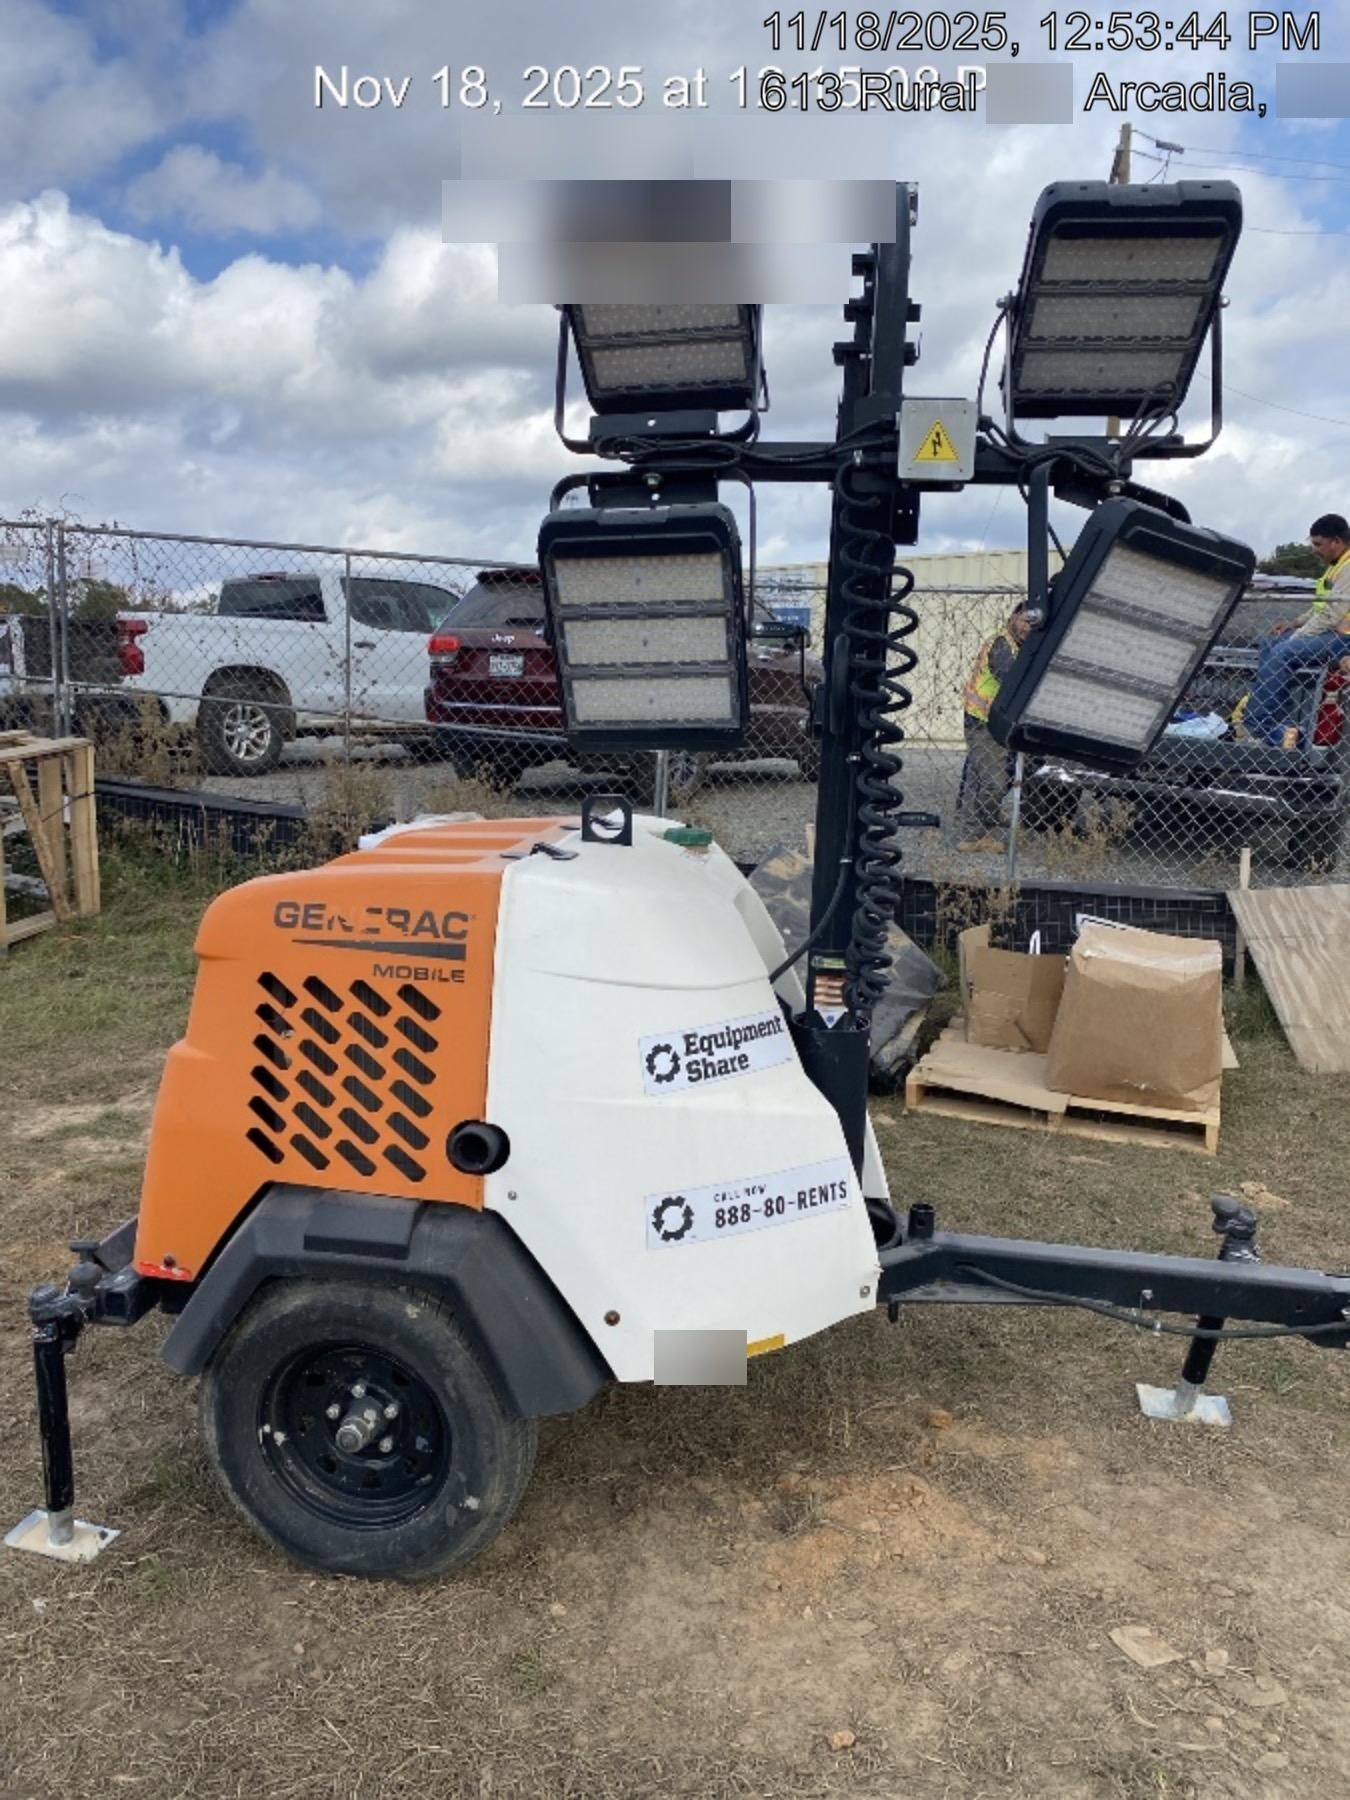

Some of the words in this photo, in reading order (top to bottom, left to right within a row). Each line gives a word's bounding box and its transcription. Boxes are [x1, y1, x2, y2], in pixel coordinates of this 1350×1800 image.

[373, 963, 465, 983] MOBILE
[683, 1015, 784, 1056] Equipment
[686, 1053, 750, 1083] Share
[714, 1180, 848, 1229] 888-80-RENTS
